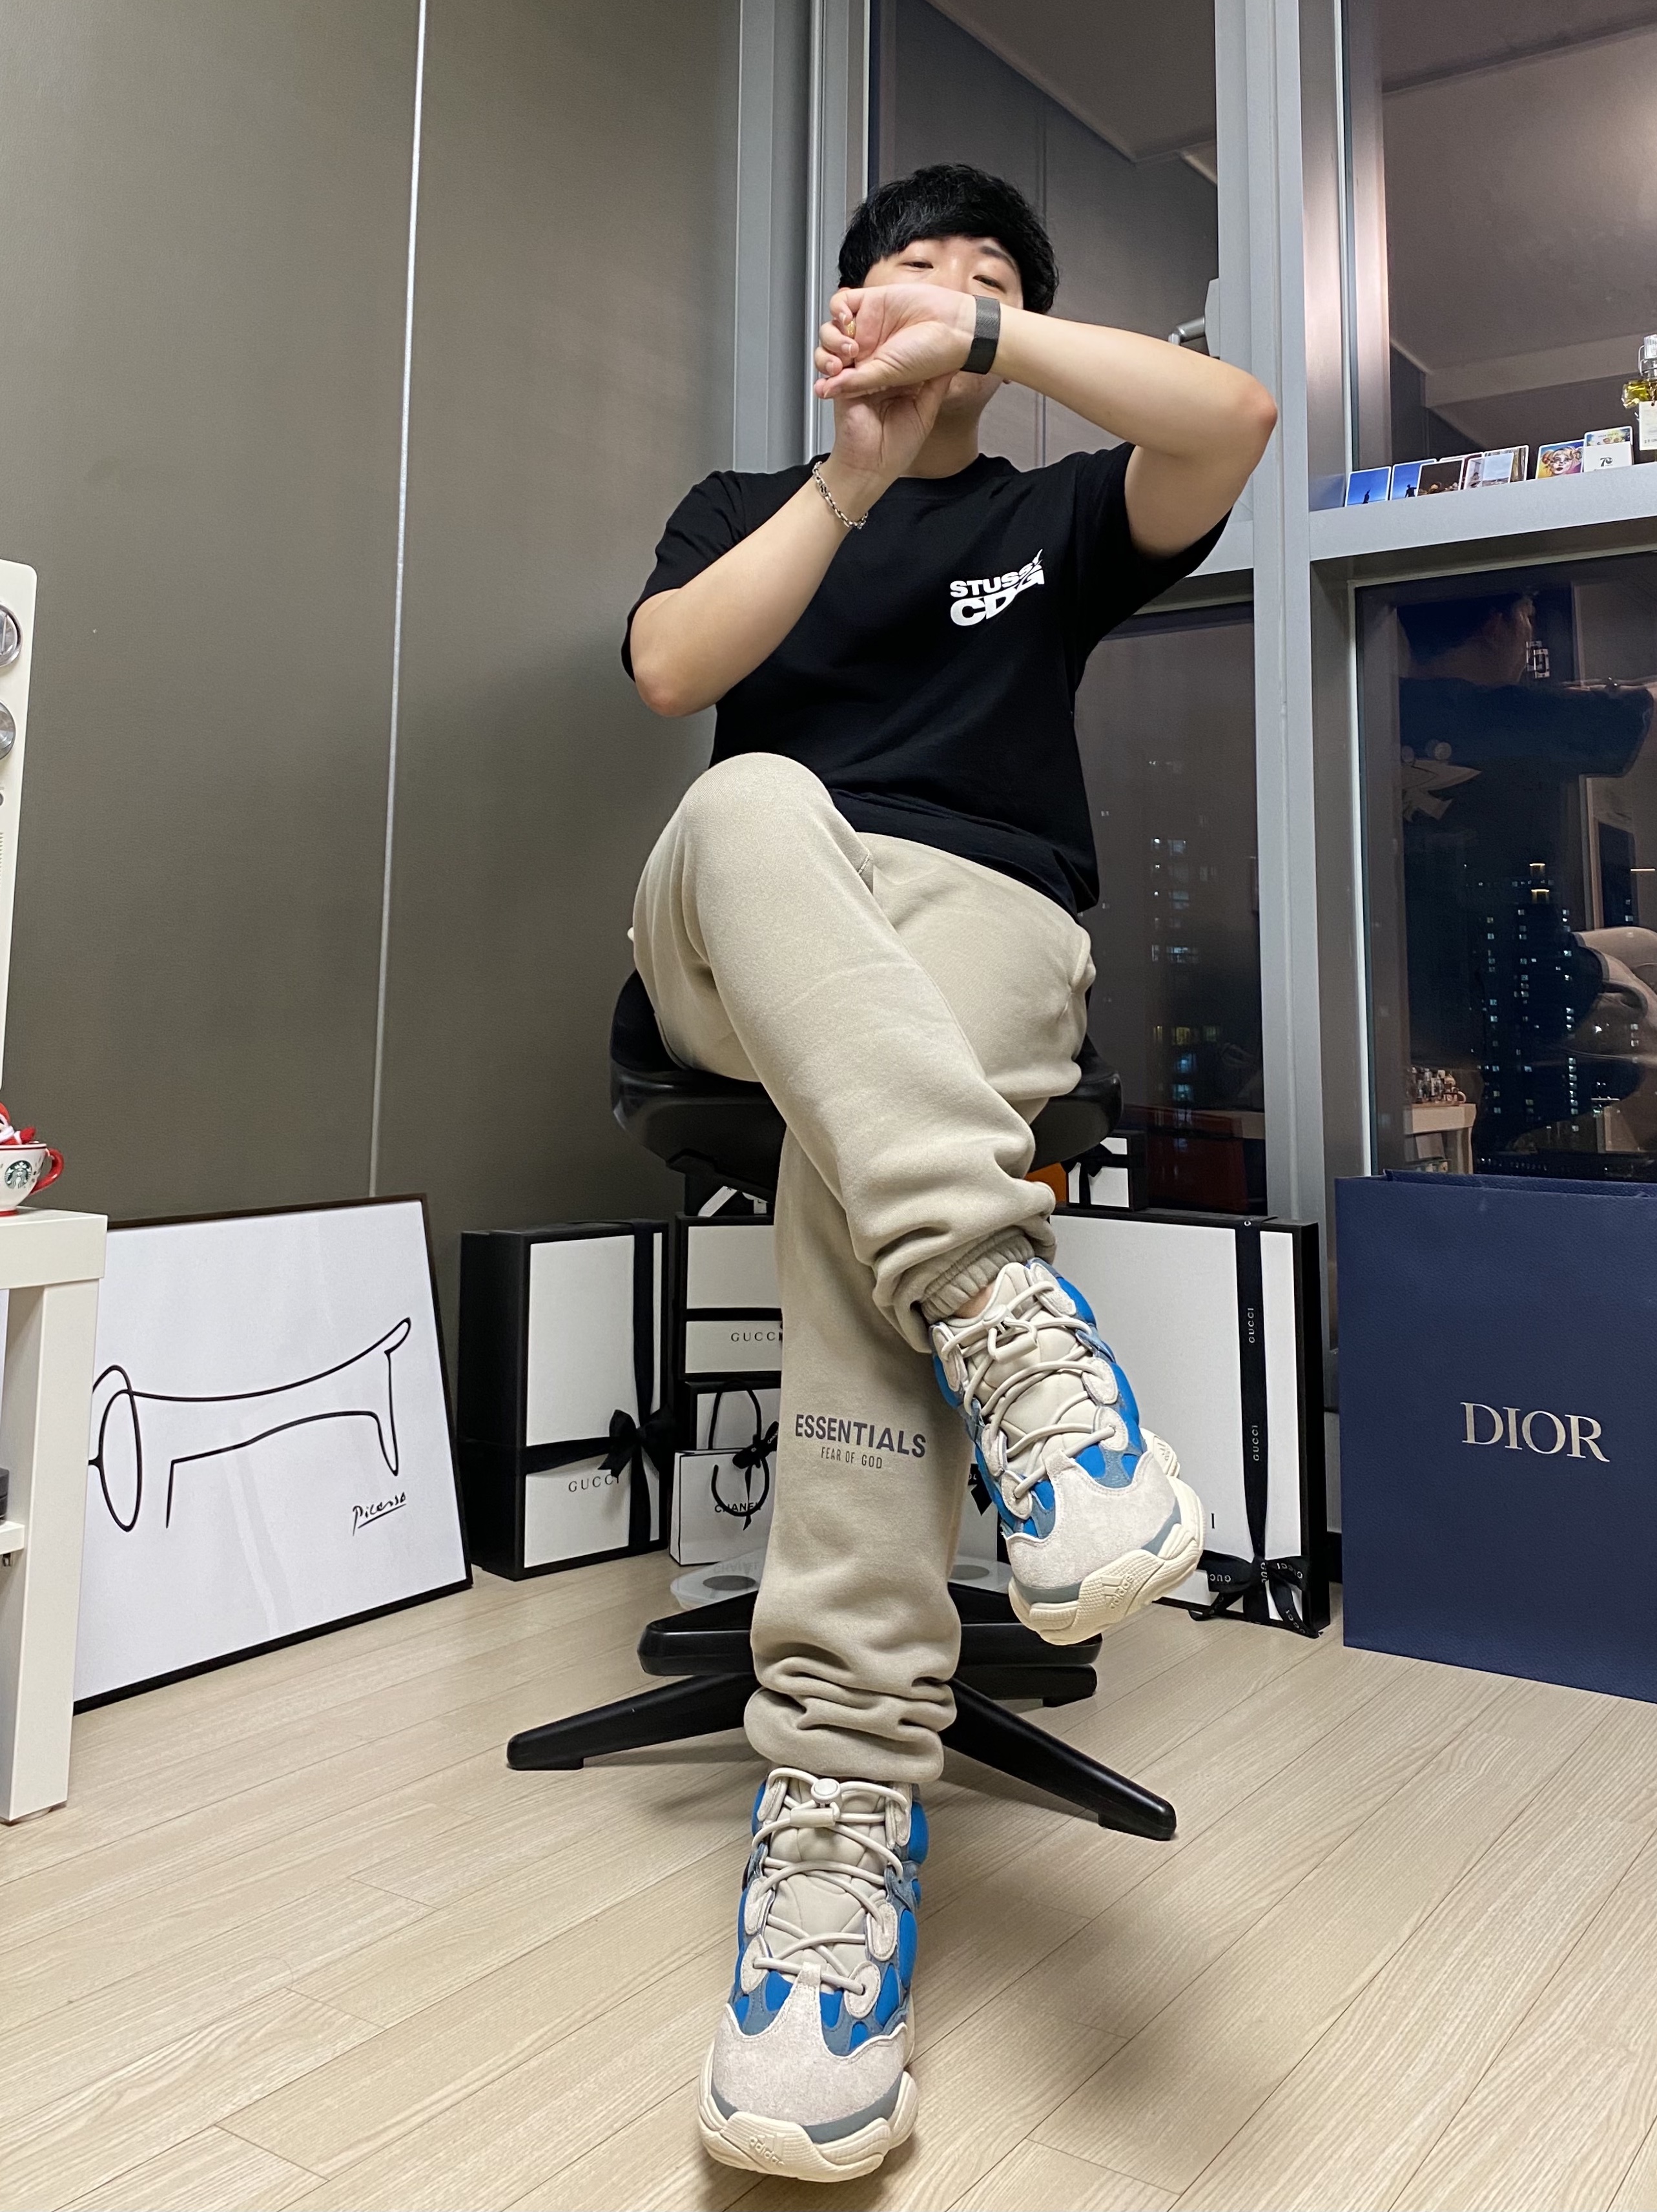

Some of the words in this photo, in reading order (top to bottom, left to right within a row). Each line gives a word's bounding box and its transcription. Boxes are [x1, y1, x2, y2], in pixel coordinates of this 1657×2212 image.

[795, 1414, 926, 1458] ESSENTIALS
[1251, 1425, 1260, 1462] GUCCI
[1460, 1402, 1611, 1463] DIOR
[821, 1447, 841, 1462] FEAR
[845, 1451, 855, 1464] OF
[861, 1454, 883, 1469] GOD
[714, 1502, 761, 1513] CANE
[1109, 1575, 1135, 1611] adidas
[1209, 1574, 1231, 1583] GUC
